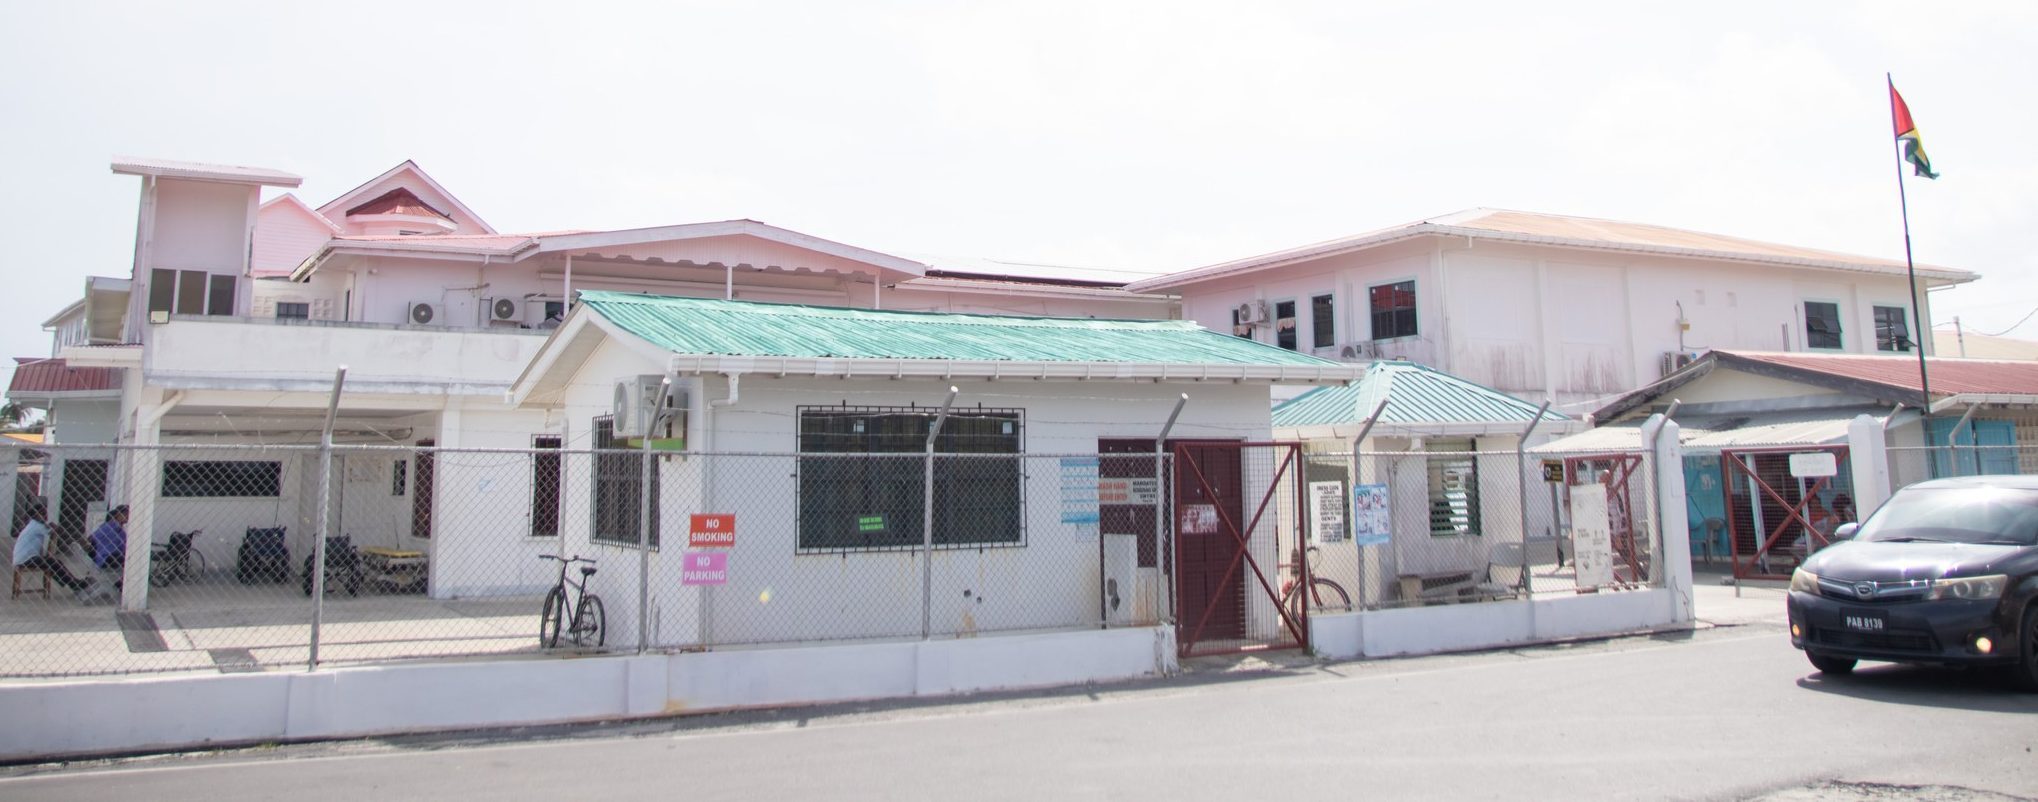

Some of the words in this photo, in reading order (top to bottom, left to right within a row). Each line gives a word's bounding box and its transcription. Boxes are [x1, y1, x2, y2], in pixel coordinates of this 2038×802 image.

[706, 518, 720, 529] NO
[691, 532, 733, 542] SMOKING
[696, 556, 711, 567] NO
[684, 570, 725, 581] PARKING
[1846, 616, 1863, 628] PAB
